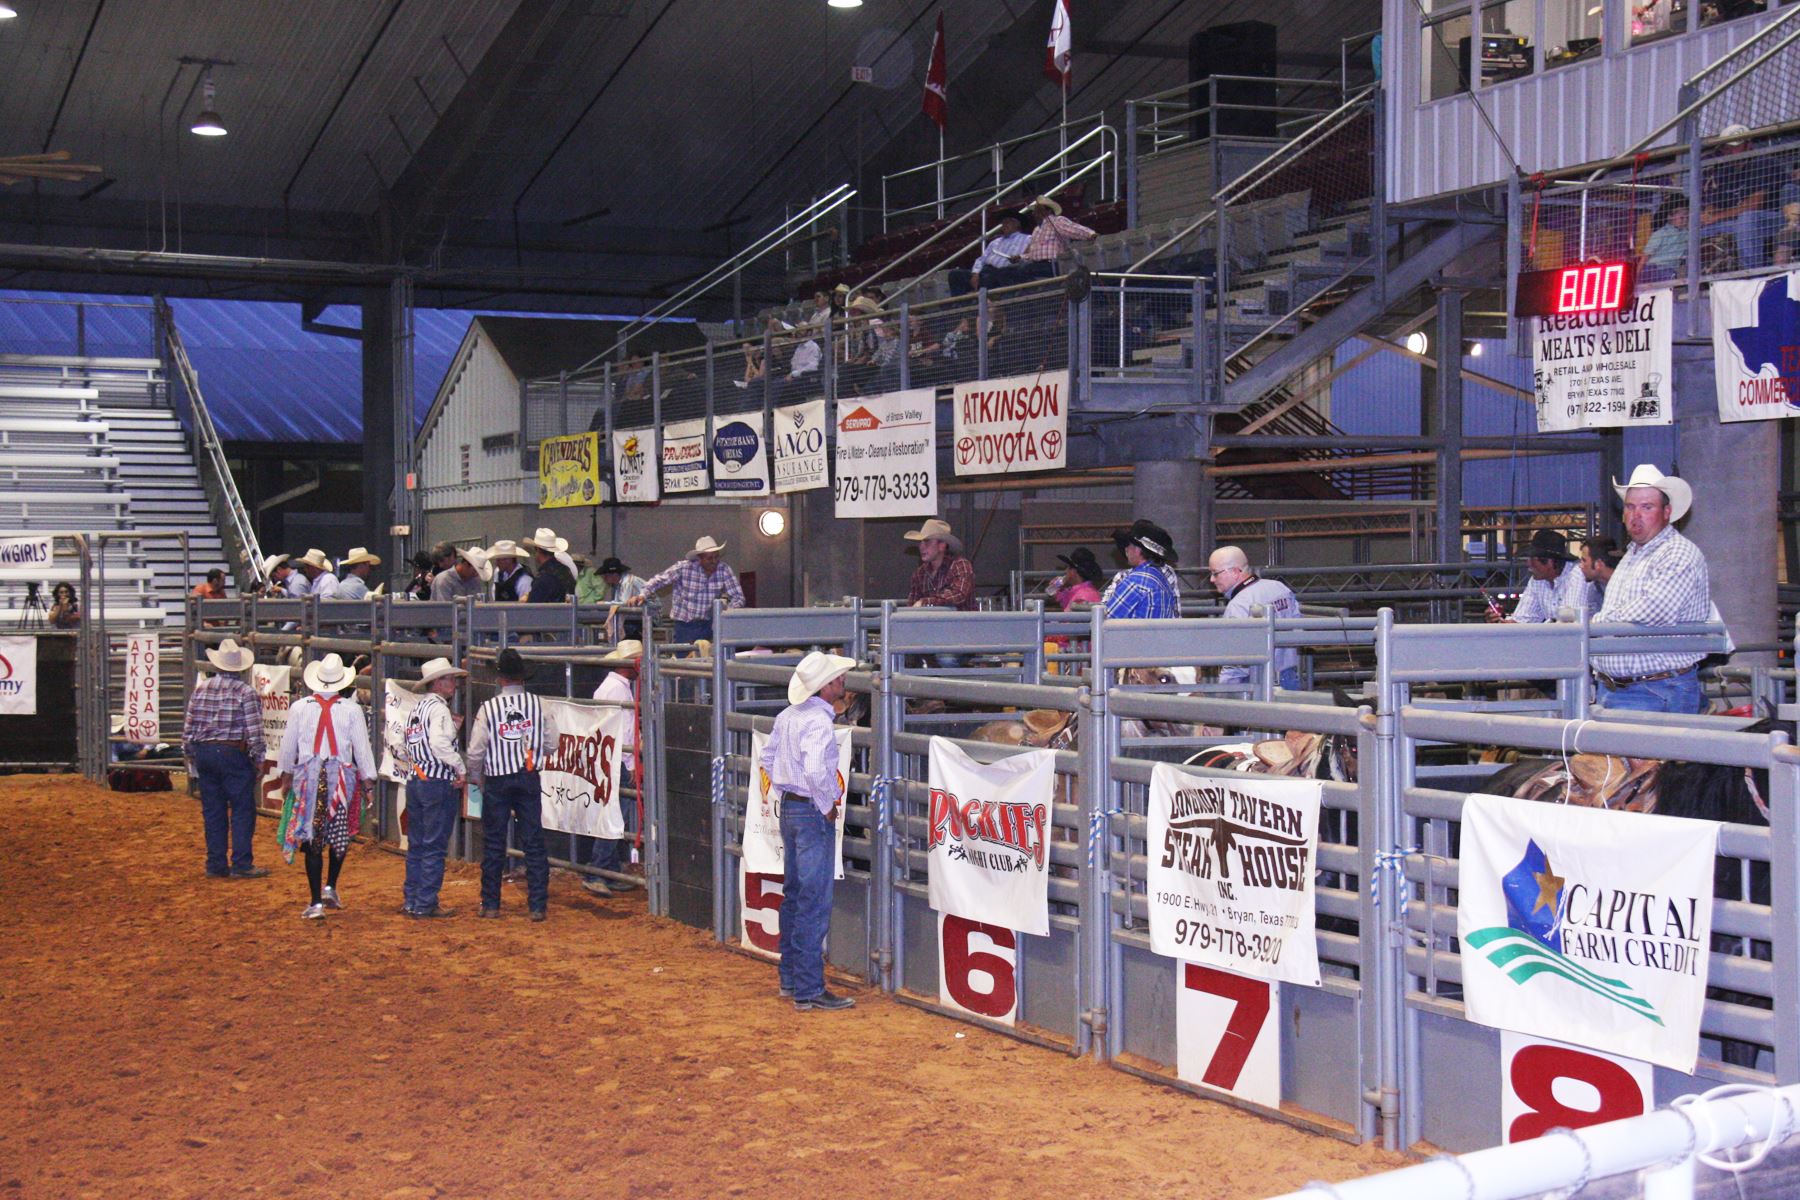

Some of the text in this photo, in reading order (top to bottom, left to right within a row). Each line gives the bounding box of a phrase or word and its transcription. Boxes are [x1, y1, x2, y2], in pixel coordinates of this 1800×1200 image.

[1541, 328, 1651, 362] MEATS & DELI
[1554, 366, 1580, 377] RETAIL
[1596, 360, 1636, 372] WHOLESALE
[905, 409, 923, 421] Valley
[963, 384, 1059, 425] ATKINSON
[775, 428, 822, 459] ANCO
[975, 431, 1048, 465] TOYOTA
[836, 471, 930, 502] 979-779-3333
[128, 640, 140, 740] ATKINSON
[144, 640, 155, 713] TOYOTA
[928, 787, 1047, 872] ROCKIES
[1229, 790, 1303, 838] TAVERN
[968, 849, 1013, 873] NIGHT CLUB
[1161, 827, 1309, 892] STEAK HOUSE
[1156, 891, 1182, 907] 1900
[1259, 910, 1284, 927] Texas
[1217, 880, 1238, 901] INC.
[1566, 883, 1701, 943] CAPITAL
[942, 913, 1016, 1018] 6
[1562, 927, 1700, 977] FARM CREDIT
[1184, 962, 1270, 1092] 7
